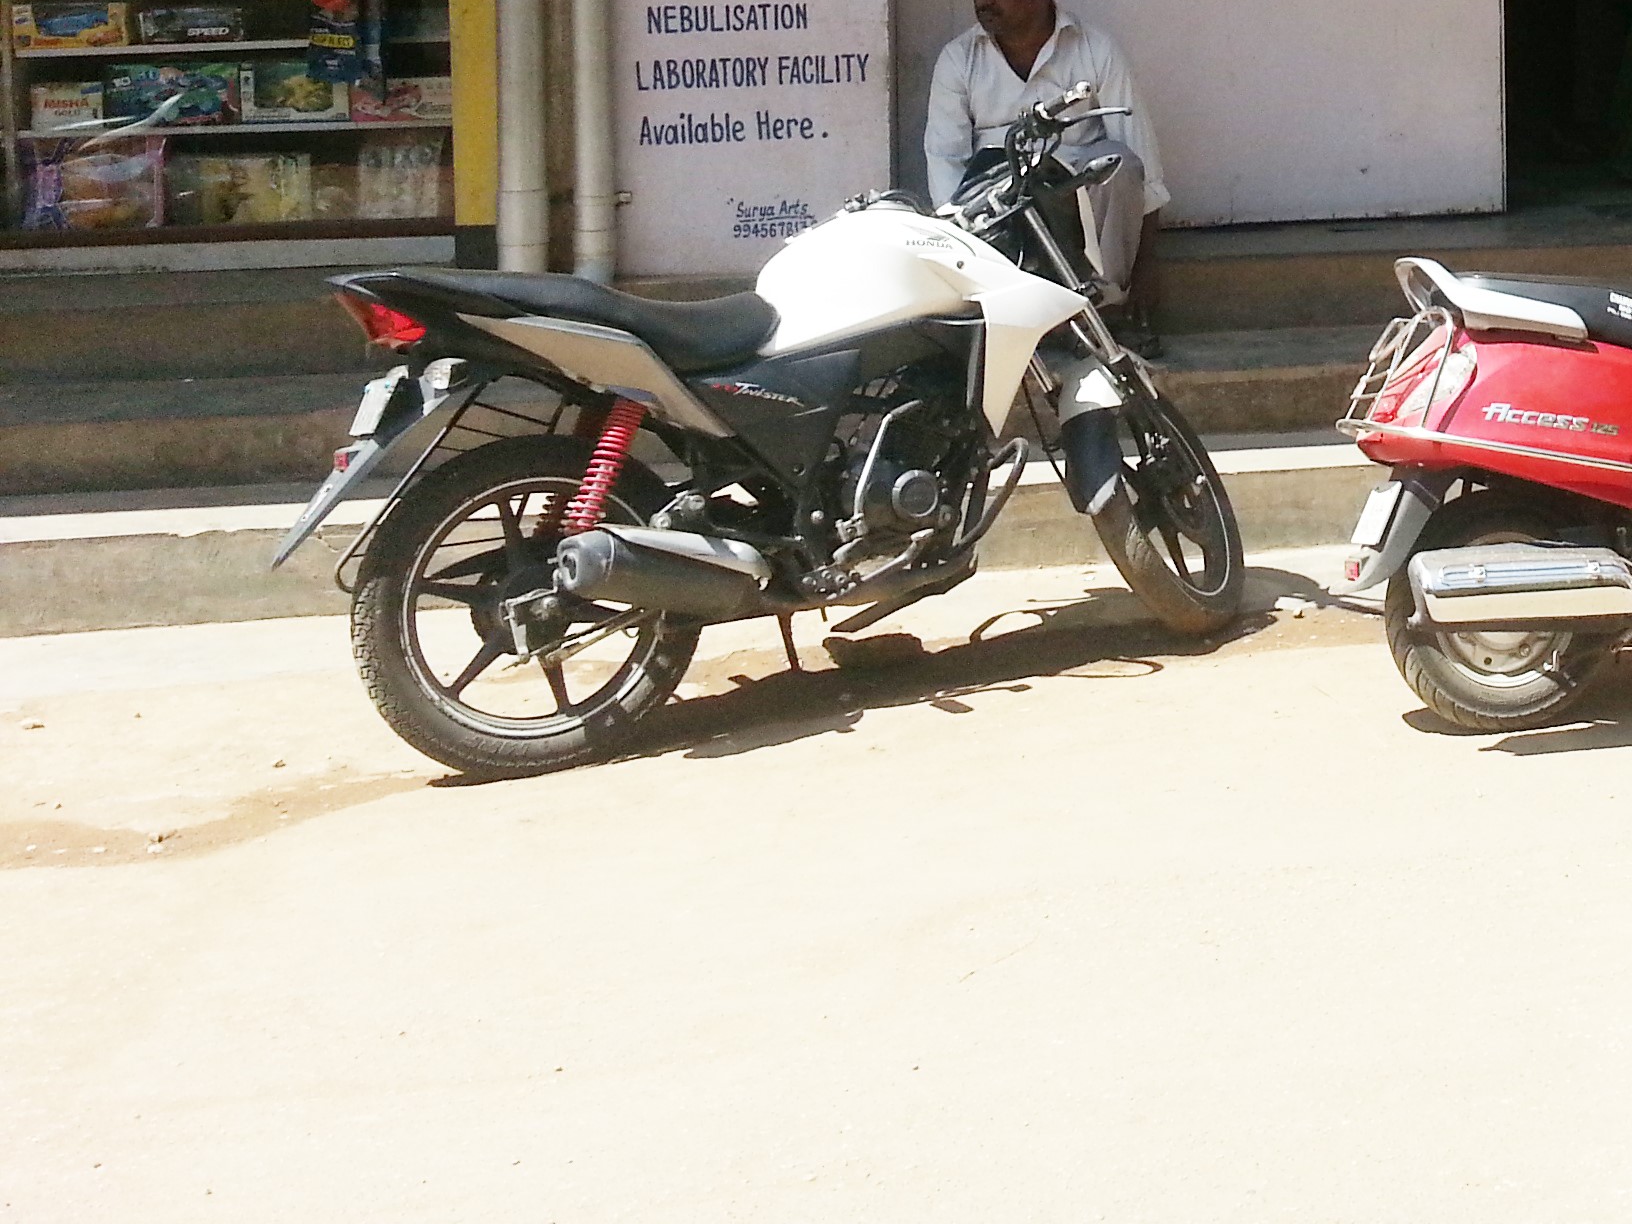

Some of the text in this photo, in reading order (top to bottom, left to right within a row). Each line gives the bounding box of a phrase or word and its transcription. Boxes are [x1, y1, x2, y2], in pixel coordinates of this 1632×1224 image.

[647, 3, 808, 34] NEBULISATION
[187, 27, 230, 37] SPEED
[635, 53, 870, 91] LABORATORY FACILITY
[639, 112, 746, 146] Available
[733, 219, 818, 239] 99456781
[905, 239, 953, 249] HONDA
